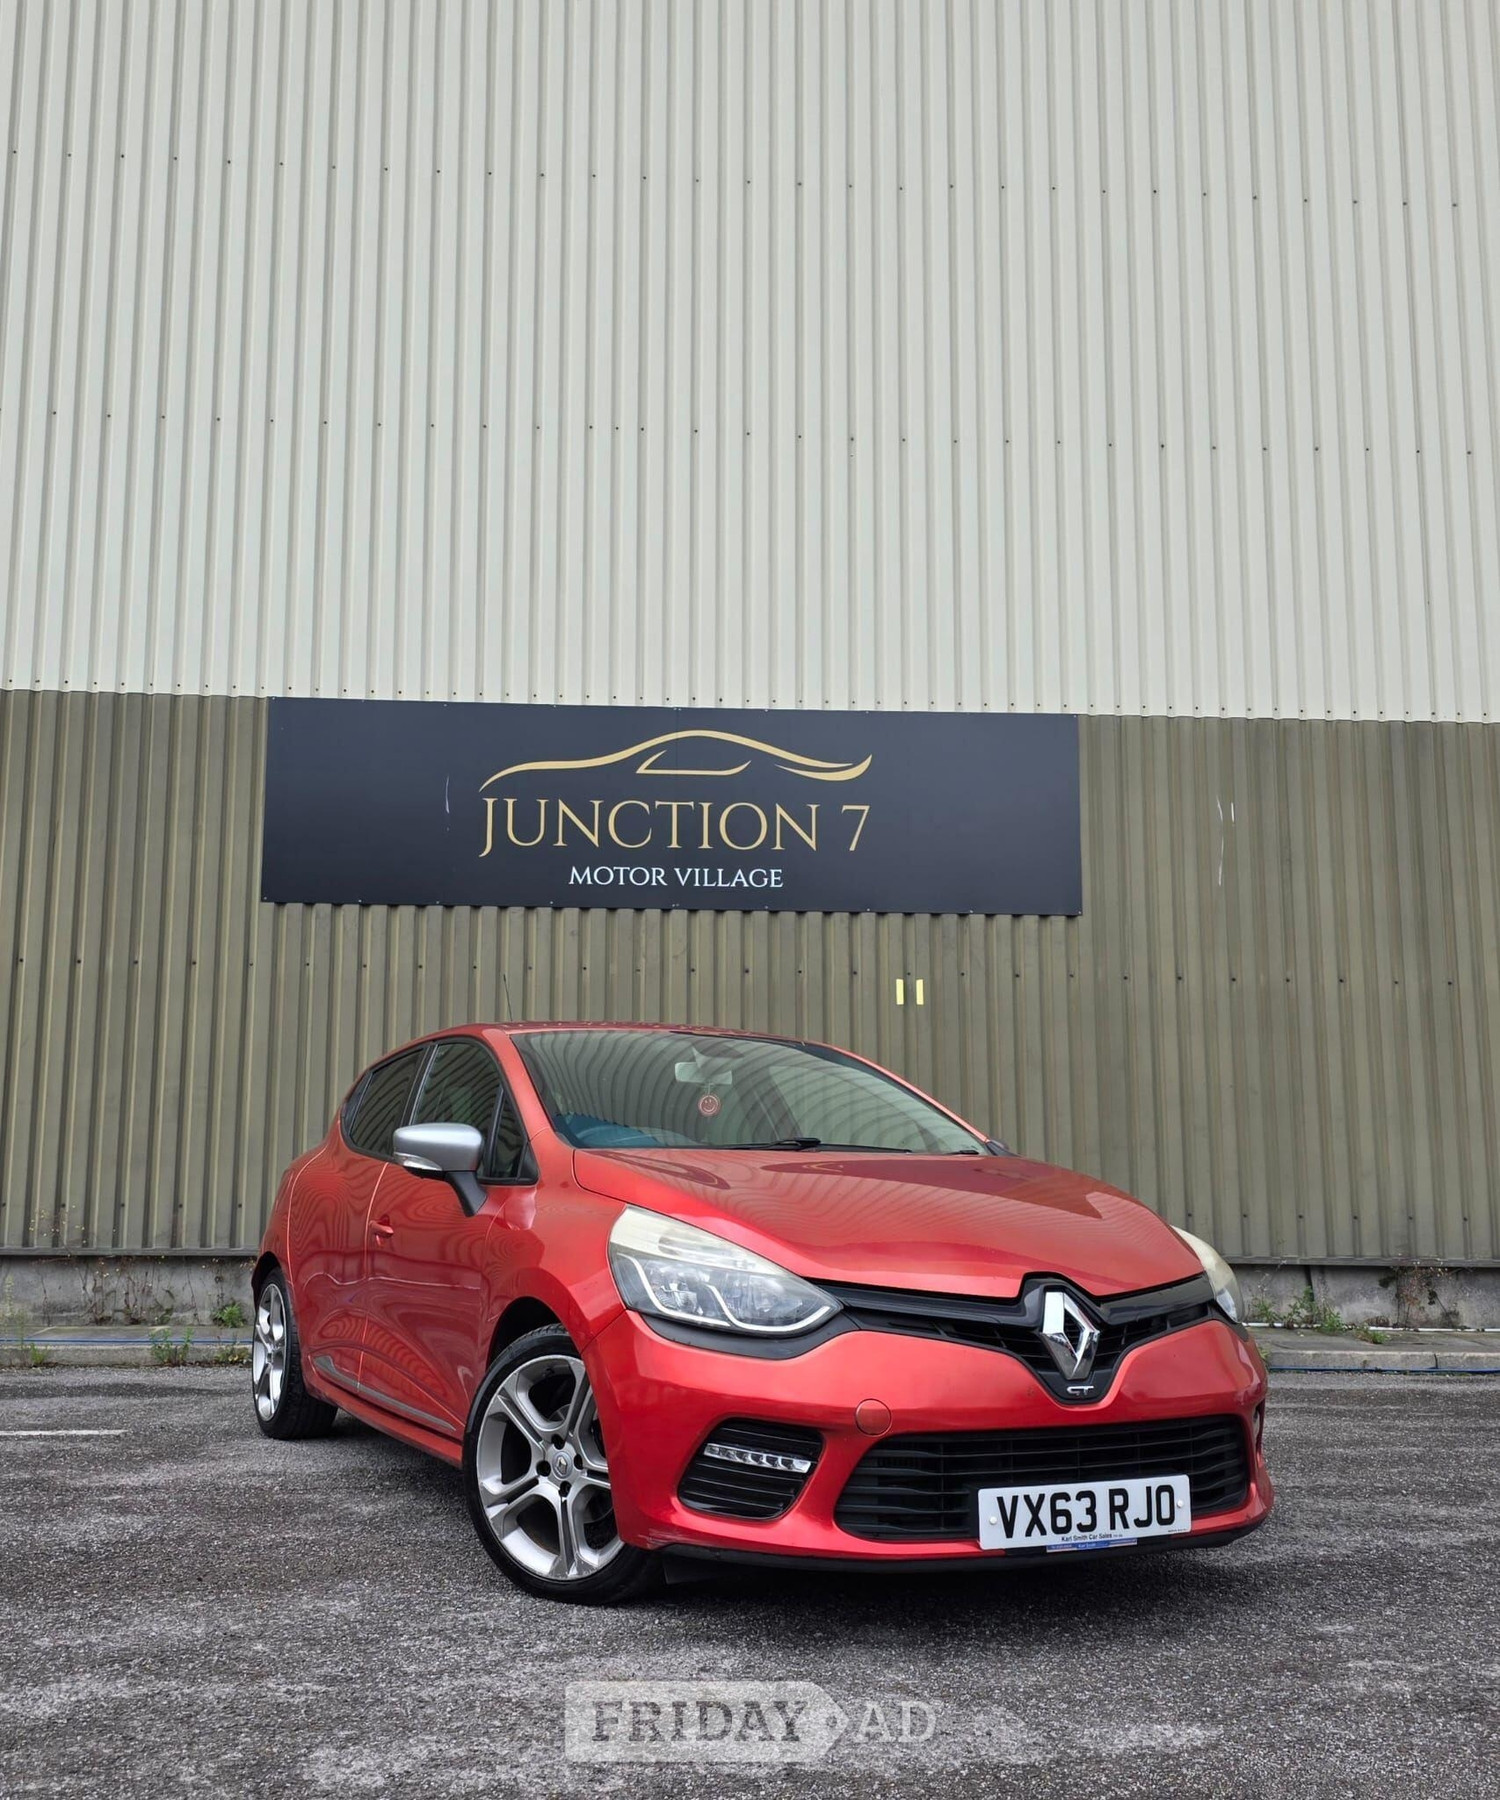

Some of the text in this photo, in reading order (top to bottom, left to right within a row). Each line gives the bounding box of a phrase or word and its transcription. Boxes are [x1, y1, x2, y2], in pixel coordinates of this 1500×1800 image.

[478, 797, 871, 858] JUNCTION 7
[568, 866, 785, 888] MOTOR VILLAGE
[996, 1484, 1176, 1539] VX63 RJO
[1099, 1532, 1113, 1540] Sales
